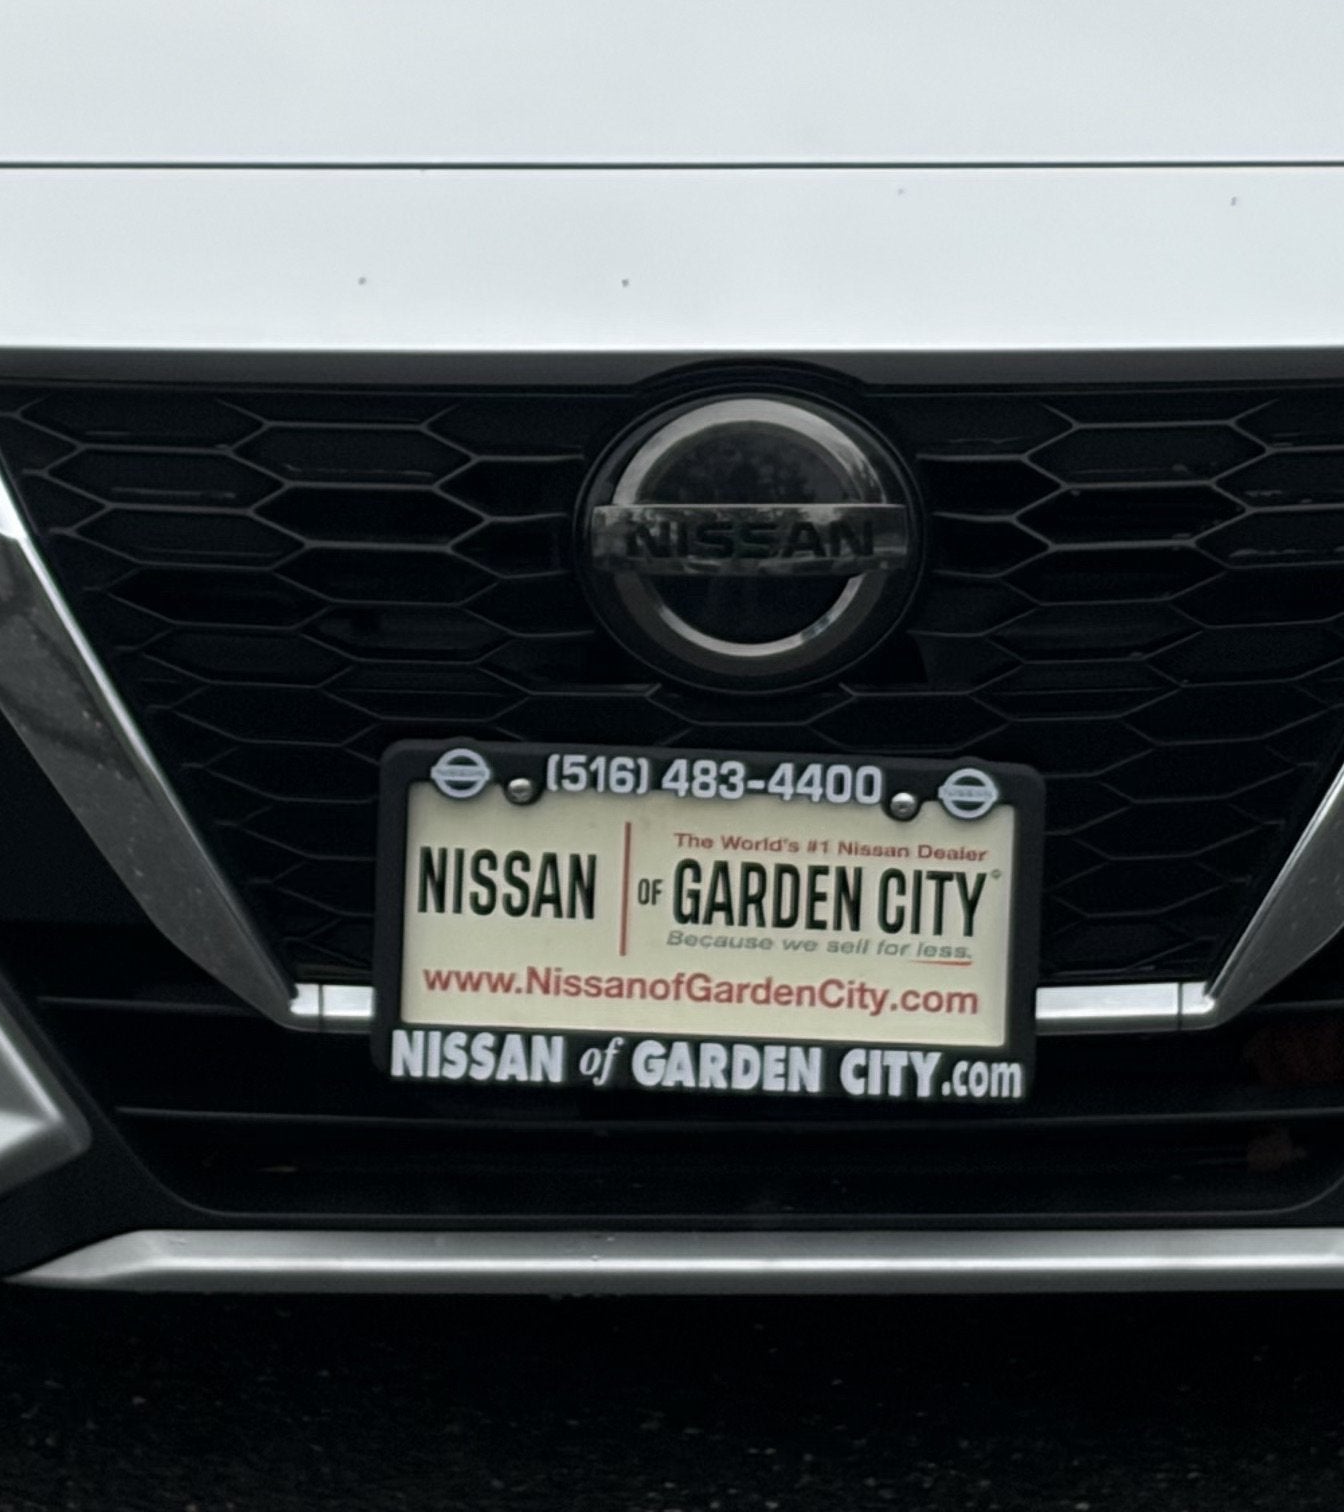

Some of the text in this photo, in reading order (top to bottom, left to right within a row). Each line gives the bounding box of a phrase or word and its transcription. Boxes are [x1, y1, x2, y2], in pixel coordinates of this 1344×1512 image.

[626, 520, 874, 559] NISSAN
[547, 754, 883, 805] (516) 483-4400
[674, 833, 988, 862] The World's #1 Nissan Dealer
[417, 846, 987, 937] NISSAN OF GARDEN CITY
[667, 930, 972, 960] Because we sell for less.
[423, 966, 979, 1016] www.NissanofGardenCity.com
[391, 1029, 564, 1082] NISSAN
[579, 1037, 625, 1086] of
[632, 1040, 823, 1093] GARDEN
